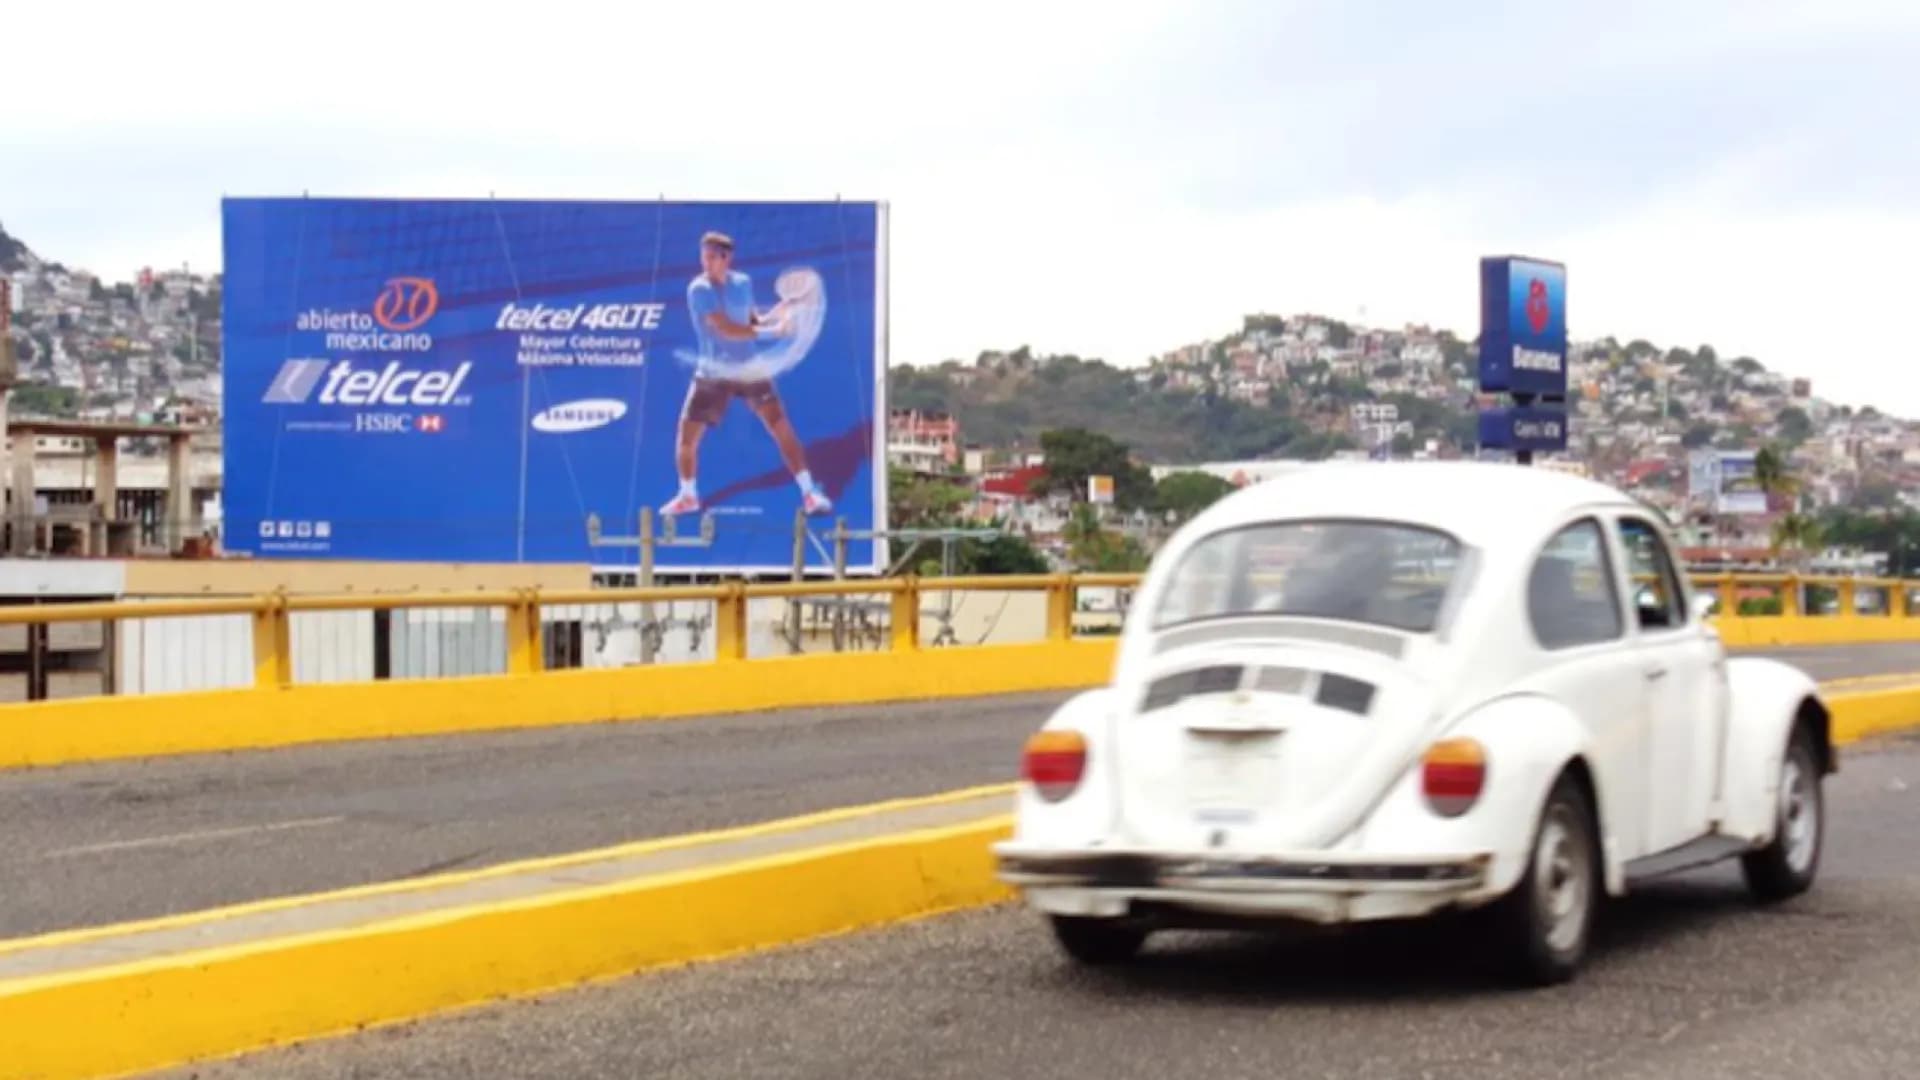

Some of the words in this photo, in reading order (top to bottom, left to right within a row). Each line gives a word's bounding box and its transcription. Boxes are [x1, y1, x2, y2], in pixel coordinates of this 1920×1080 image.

[297, 308, 373, 330] abierto
[495, 303, 583, 330] telcel
[326, 329, 432, 351] mexicano
[519, 334, 566, 352] Mayor
[569, 334, 642, 349] Cobertura
[576, 350, 644, 366] Velocidad
[317, 360, 473, 405] telcel
[355, 411, 413, 433] HSBC
